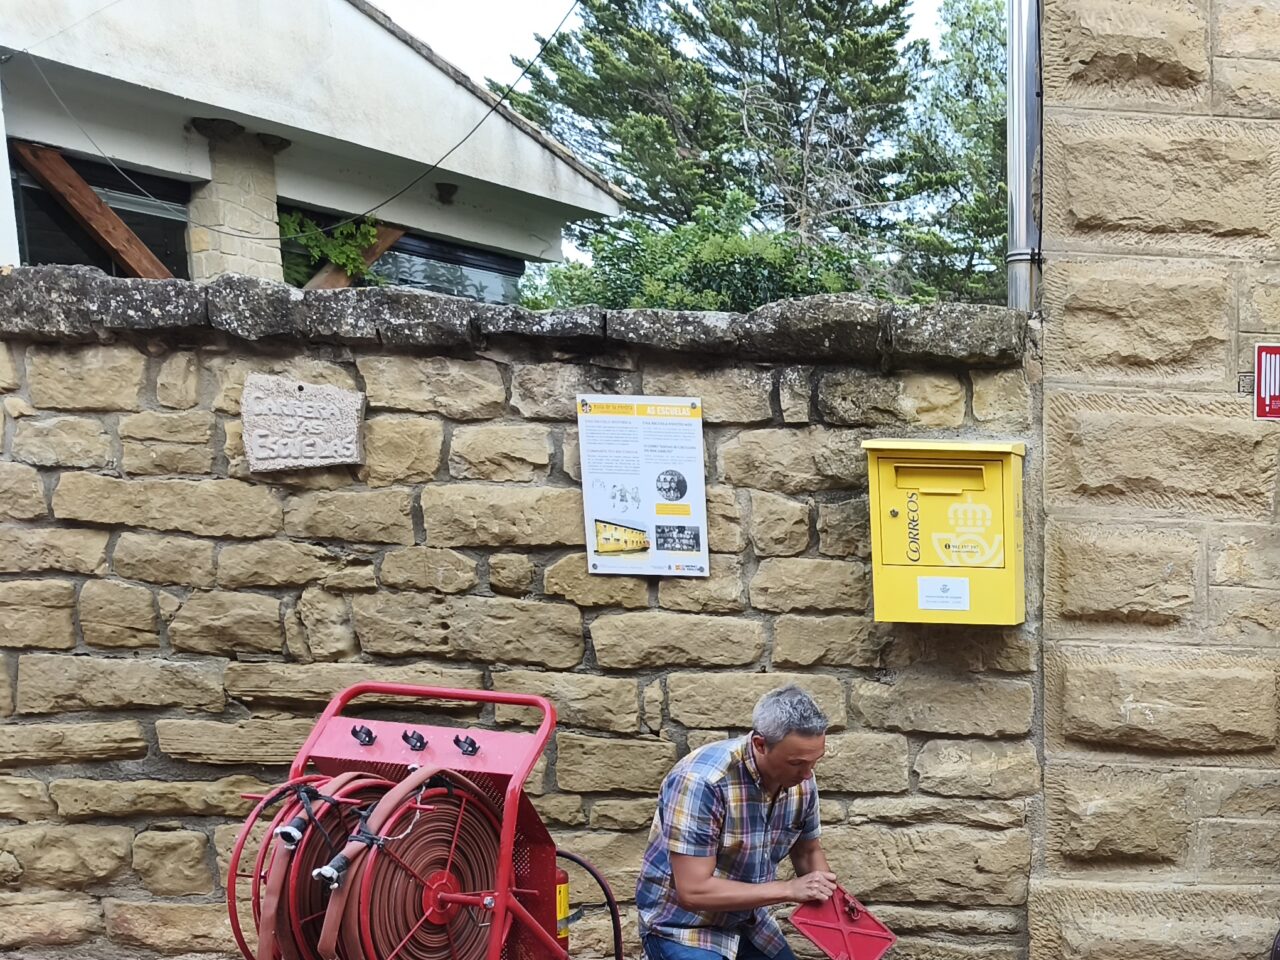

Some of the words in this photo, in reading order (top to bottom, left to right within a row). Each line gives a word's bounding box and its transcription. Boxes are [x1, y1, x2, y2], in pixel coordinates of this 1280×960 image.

[647, 405, 656, 415] AS
[657, 406, 691, 417] ESCUELAS
[252, 429, 357, 460] ESCUELAS
[906, 492, 920, 562] CORREOS
